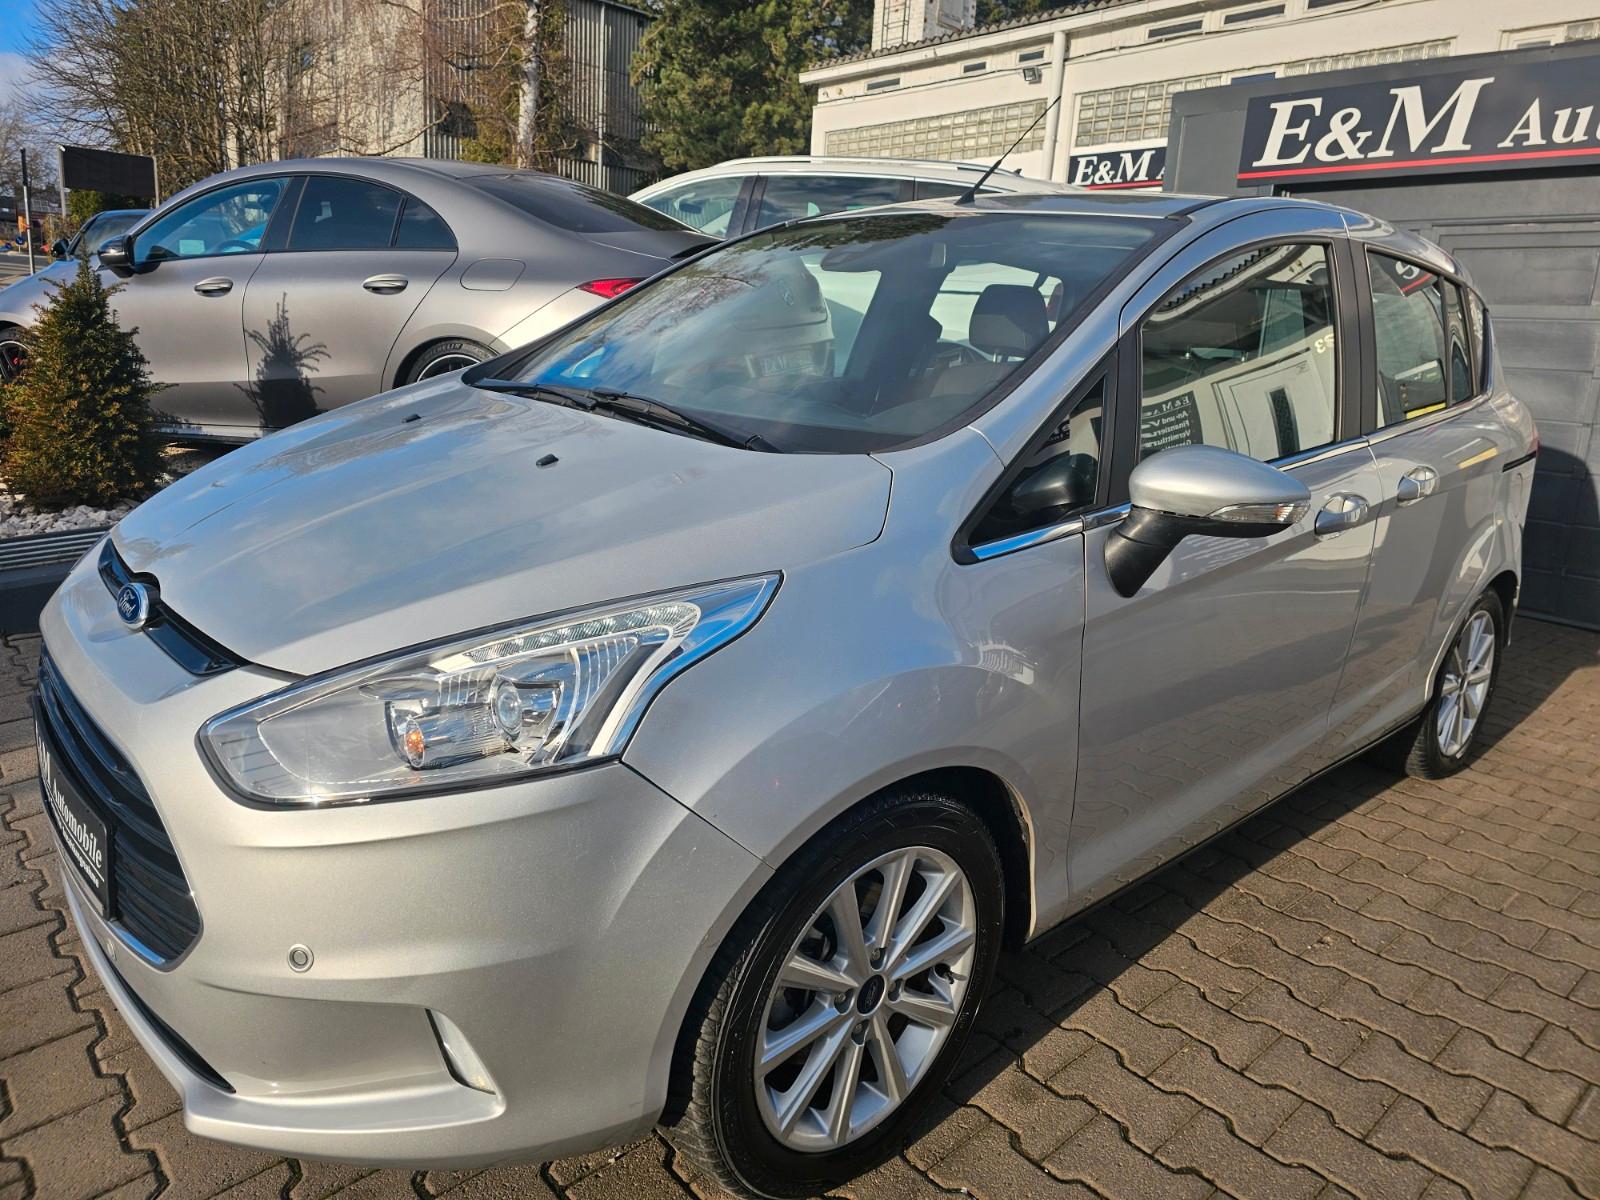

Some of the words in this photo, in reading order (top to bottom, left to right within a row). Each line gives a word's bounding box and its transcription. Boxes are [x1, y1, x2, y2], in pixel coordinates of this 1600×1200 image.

[1253, 77, 1495, 166] E&M
[1497, 97, 1600, 148] Au
[1071, 150, 1156, 186] E&M
[53, 779, 102, 869] Automobile
